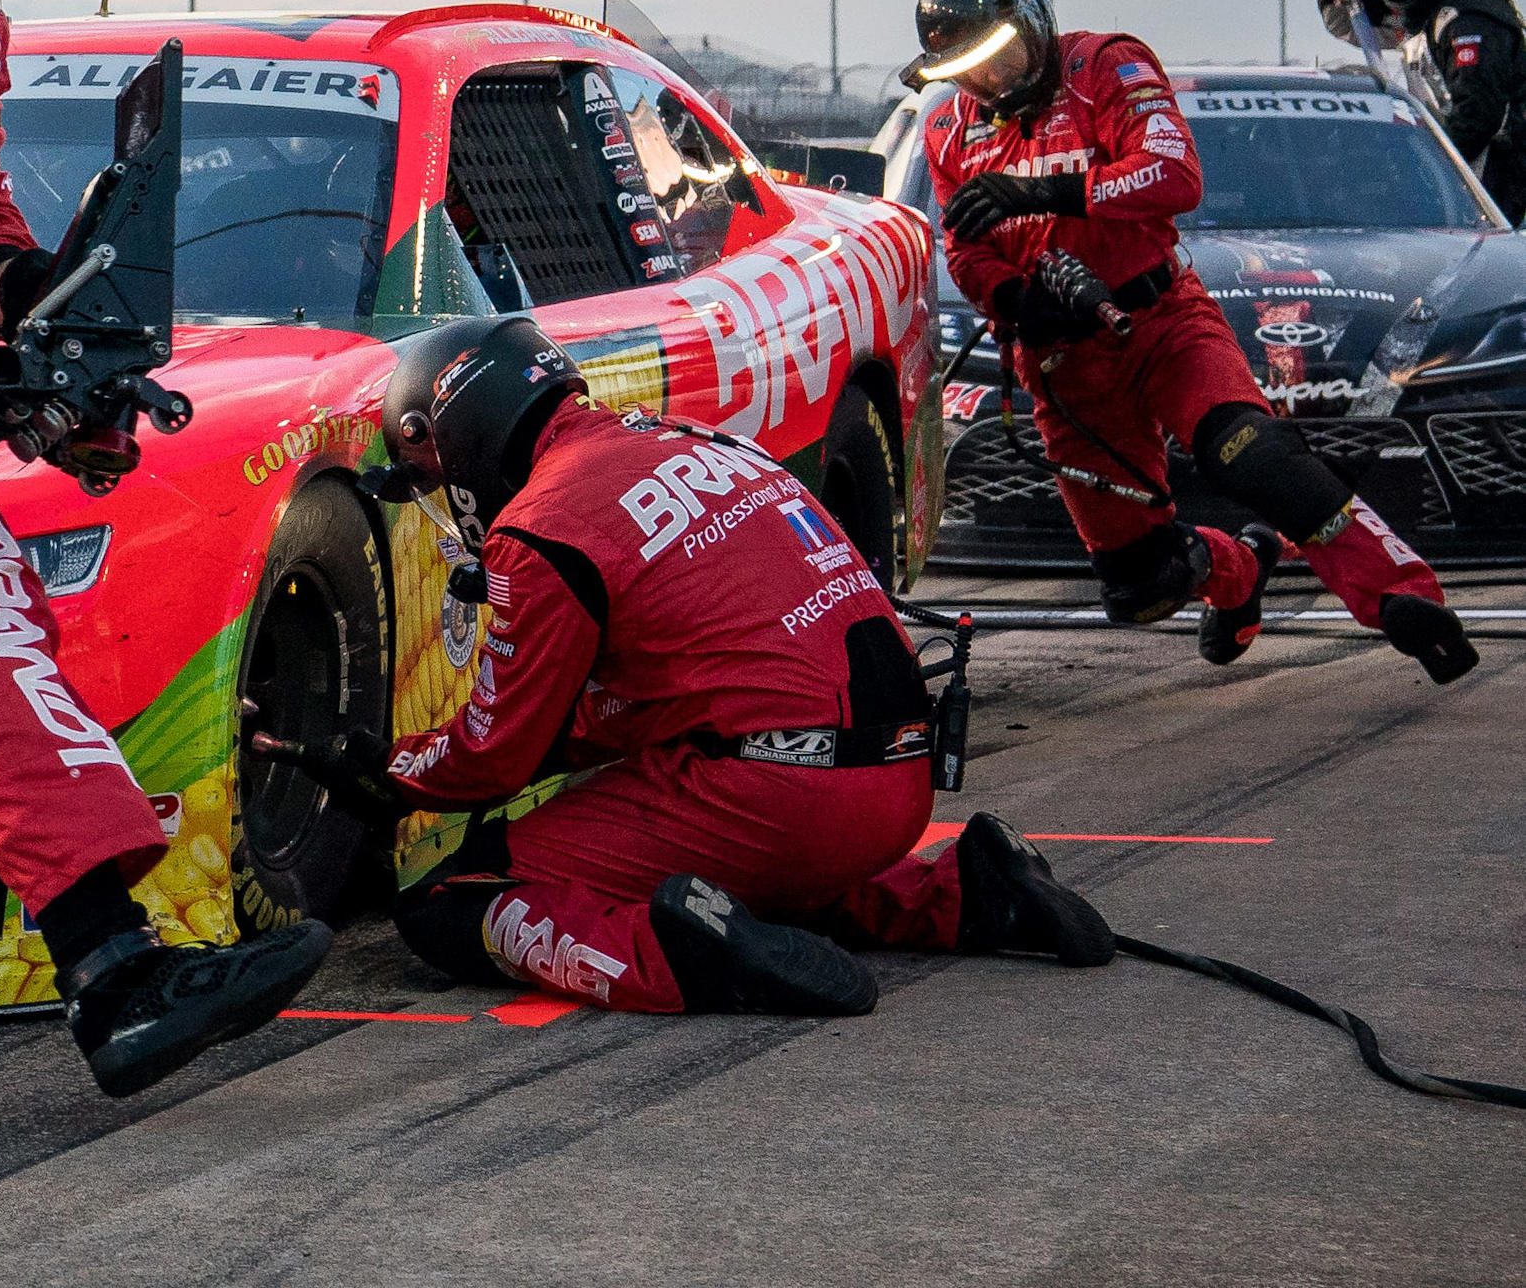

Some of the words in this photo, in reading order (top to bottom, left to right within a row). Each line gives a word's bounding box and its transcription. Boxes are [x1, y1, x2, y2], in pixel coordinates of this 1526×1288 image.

[585, 97, 620, 114] AXALTA
[1197, 97, 1371, 114] BURTON
[635, 225, 661, 241] SEM
[1262, 287, 1396, 303] FOUNDATION
[243, 406, 377, 486] GOODYEAR
[618, 435, 786, 562] BRAN
[744, 745, 798, 764] MECHANIX
[798, 752, 831, 766] WEAR
